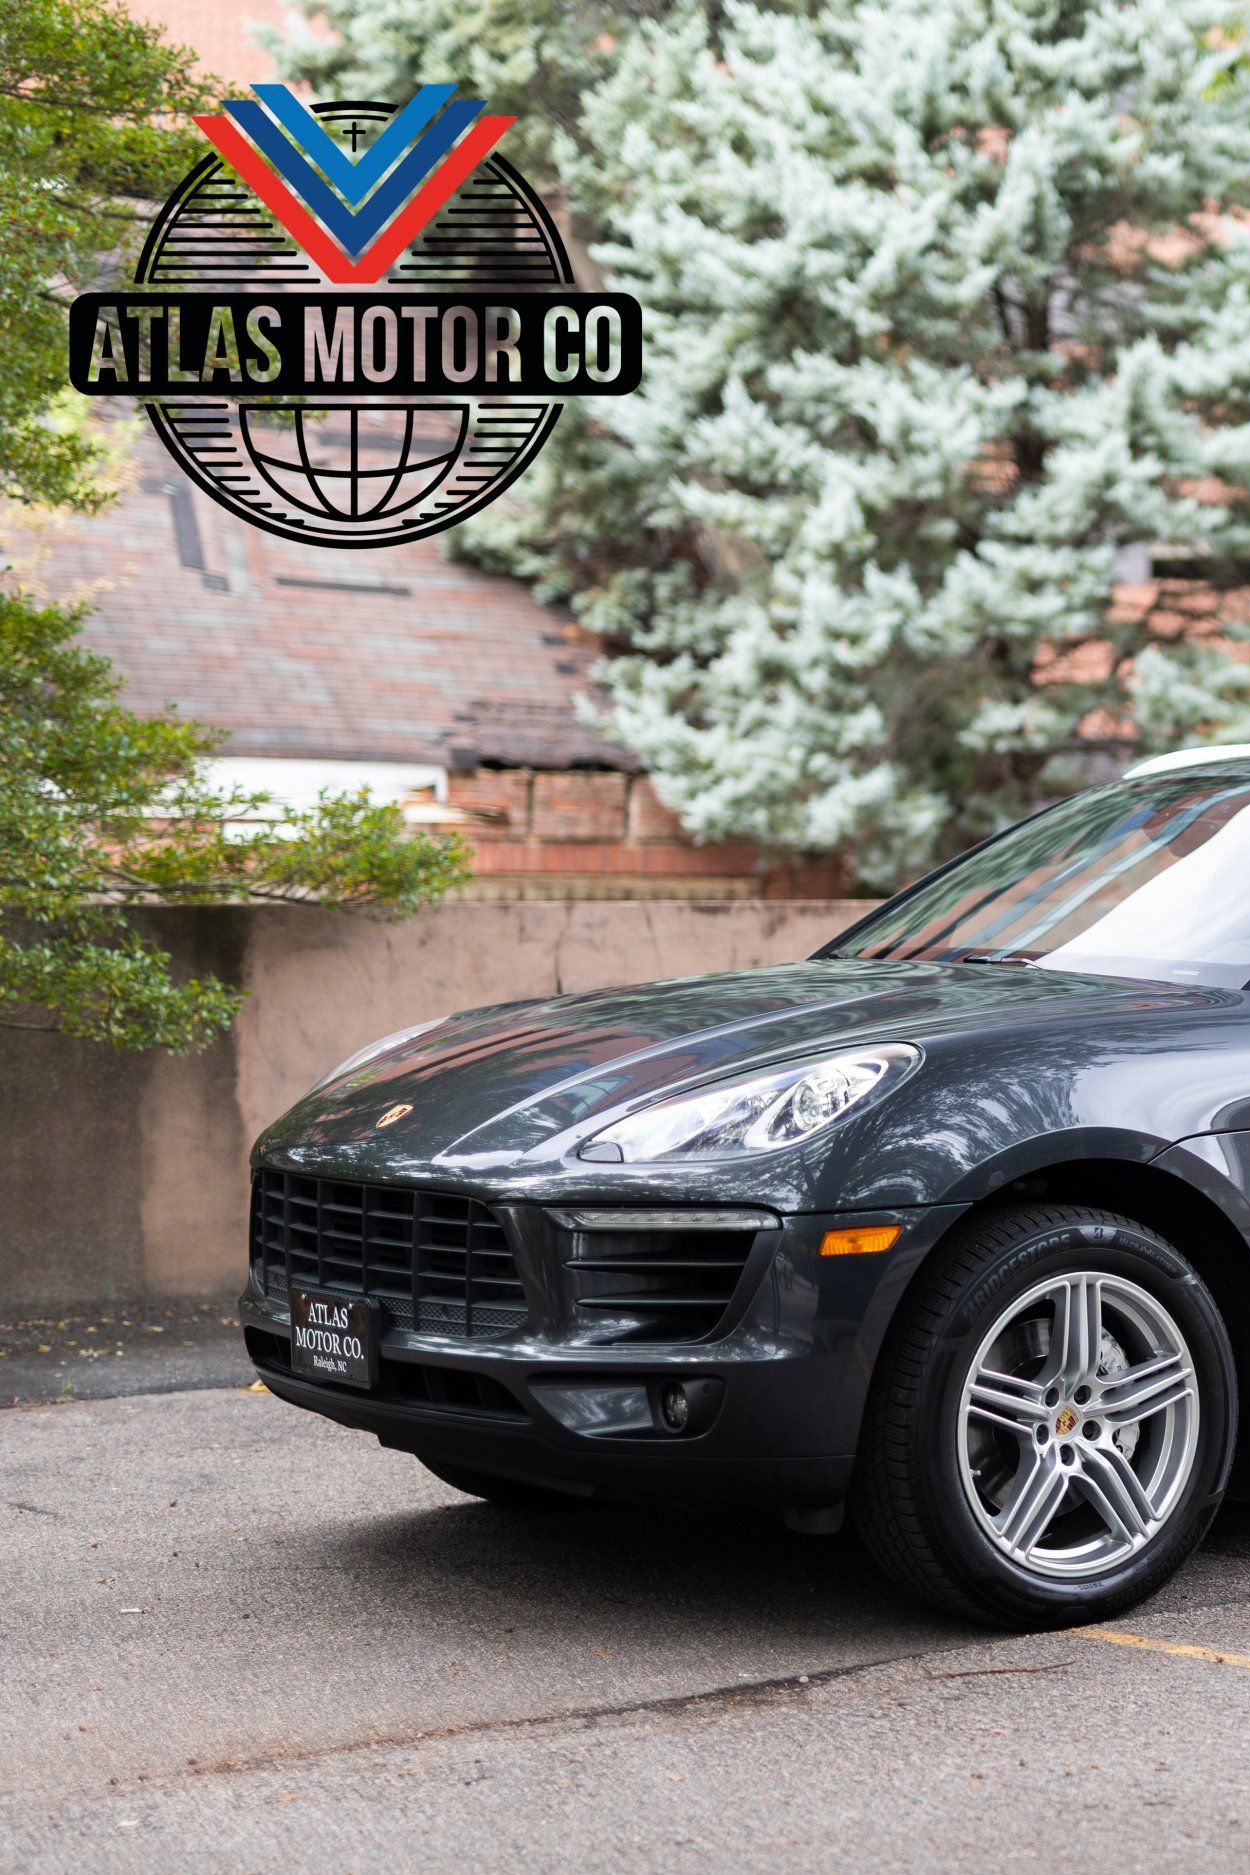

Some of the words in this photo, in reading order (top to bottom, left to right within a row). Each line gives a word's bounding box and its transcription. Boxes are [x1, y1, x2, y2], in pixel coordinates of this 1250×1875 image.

[962, 1233, 1070, 1320] BRIDGESTONE
[308, 1302, 348, 1328] ATLAS
[295, 1326, 342, 1355] MOTOR
[343, 1337, 364, 1359] CO.
[313, 1355, 337, 1372] Raleigh,
[338, 1361, 347, 1372] NC
